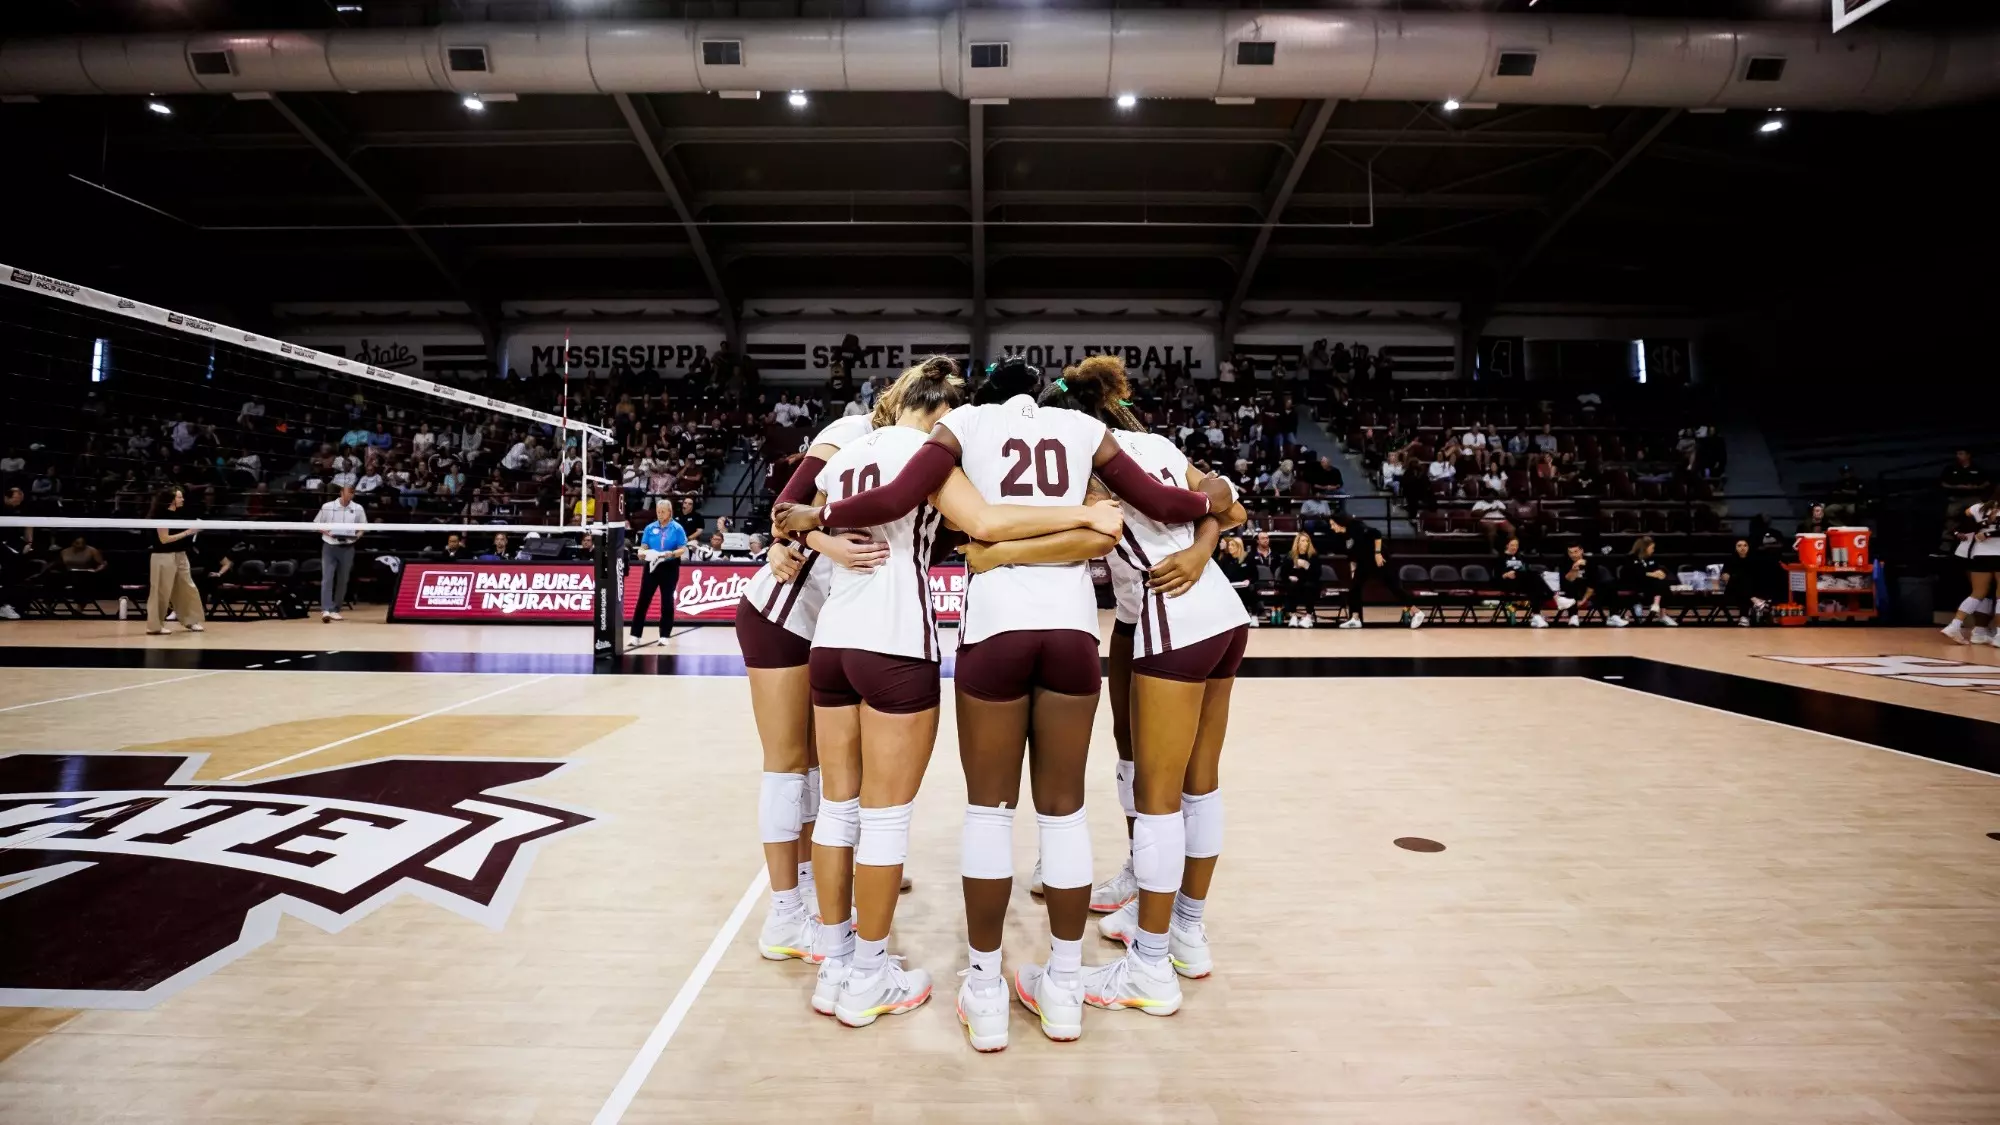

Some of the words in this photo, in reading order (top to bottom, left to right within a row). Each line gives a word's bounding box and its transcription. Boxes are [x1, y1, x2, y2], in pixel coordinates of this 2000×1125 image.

[36, 281, 76, 297] INSURANCE
[355, 339, 417, 369] State
[1000, 438, 1069, 497] 20
[839, 462, 881, 500] 10
[1814, 539, 1824, 551] G
[1854, 534, 1867, 549] G
[437, 575, 468, 586] FARM
[530, 572, 595, 591] BUREA
[422, 585, 468, 596] BUREAU
[676, 569, 750, 615] State
[480, 593, 591, 612] INSURANCE
